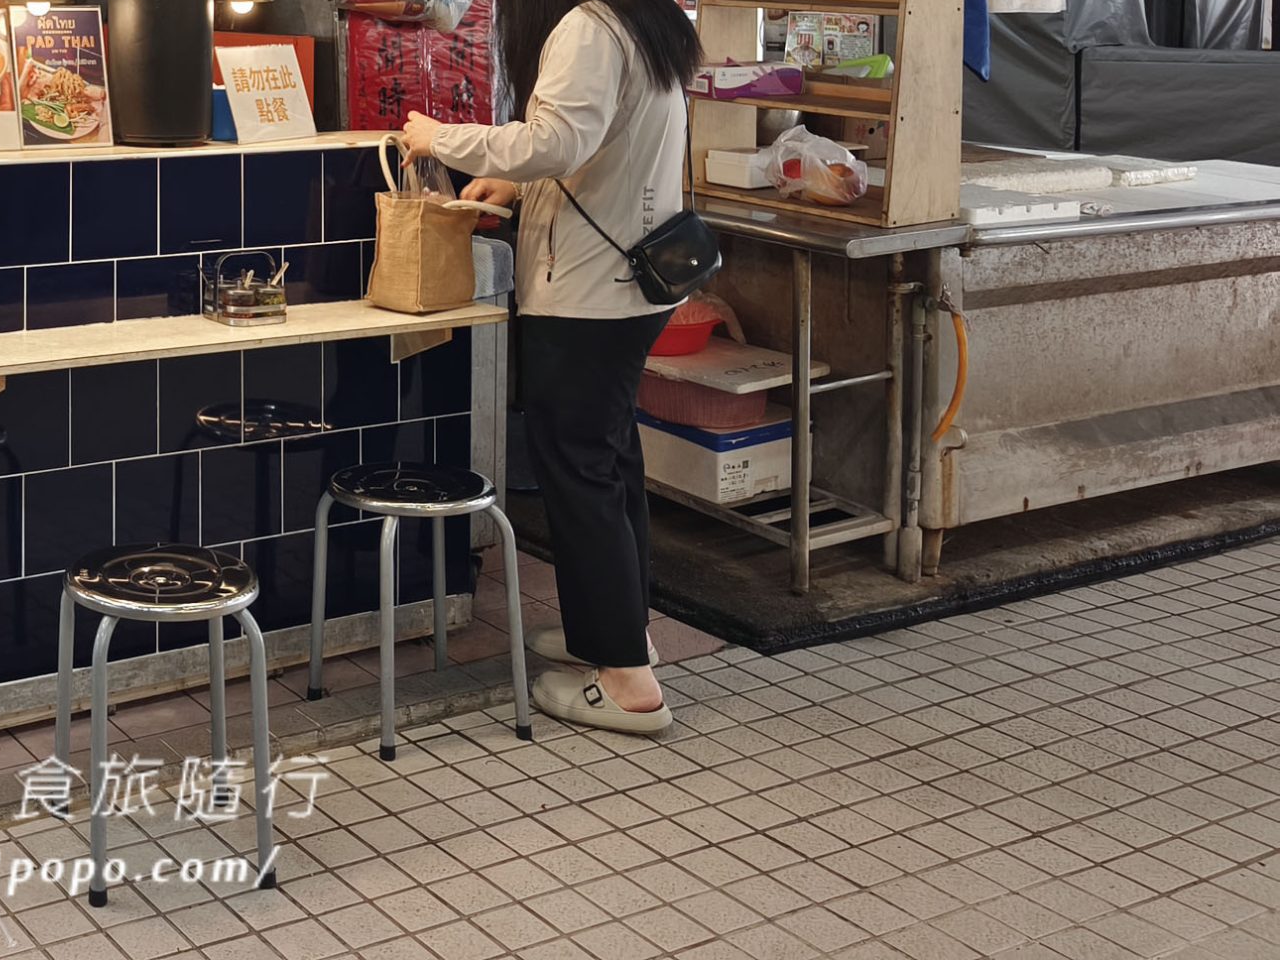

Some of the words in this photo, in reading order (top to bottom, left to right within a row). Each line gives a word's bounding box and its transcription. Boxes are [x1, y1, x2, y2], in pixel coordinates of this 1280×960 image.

[26, 35, 55, 49] PAD
[62, 35, 95, 48] THAI
[231, 65, 297, 93] 請勿在此
[255, 97, 290, 123] 點餐
